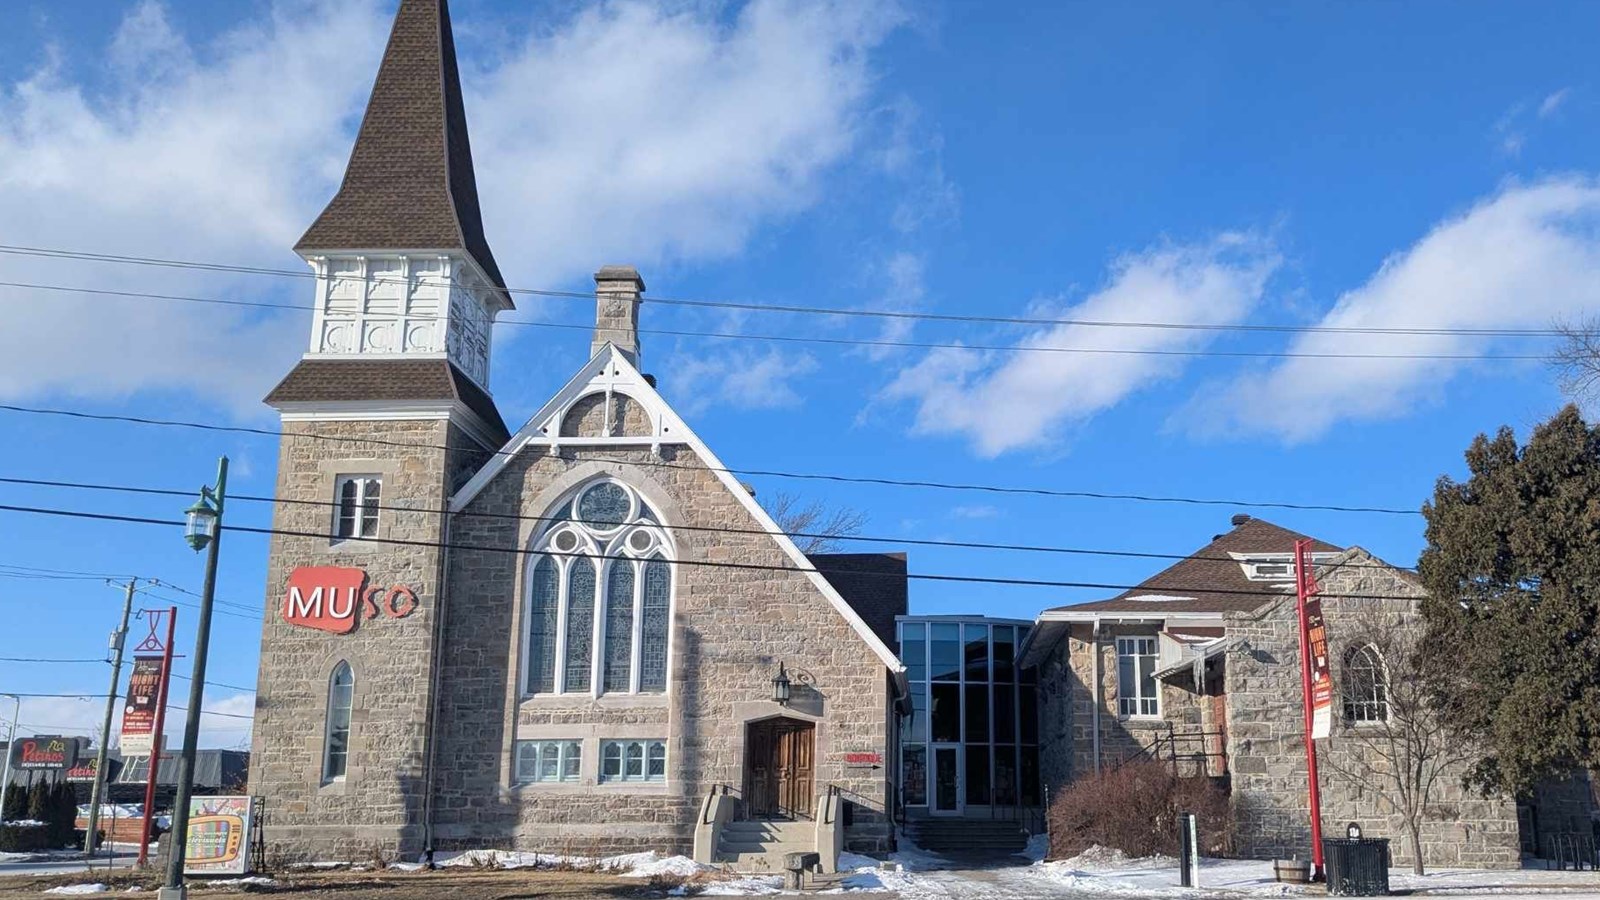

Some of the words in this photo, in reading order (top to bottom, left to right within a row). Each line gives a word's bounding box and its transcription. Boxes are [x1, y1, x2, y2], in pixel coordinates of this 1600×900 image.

[288, 584, 415, 619] MUSO
[132, 674, 160, 685] NIGHT
[132, 685, 154, 696] LIFE
